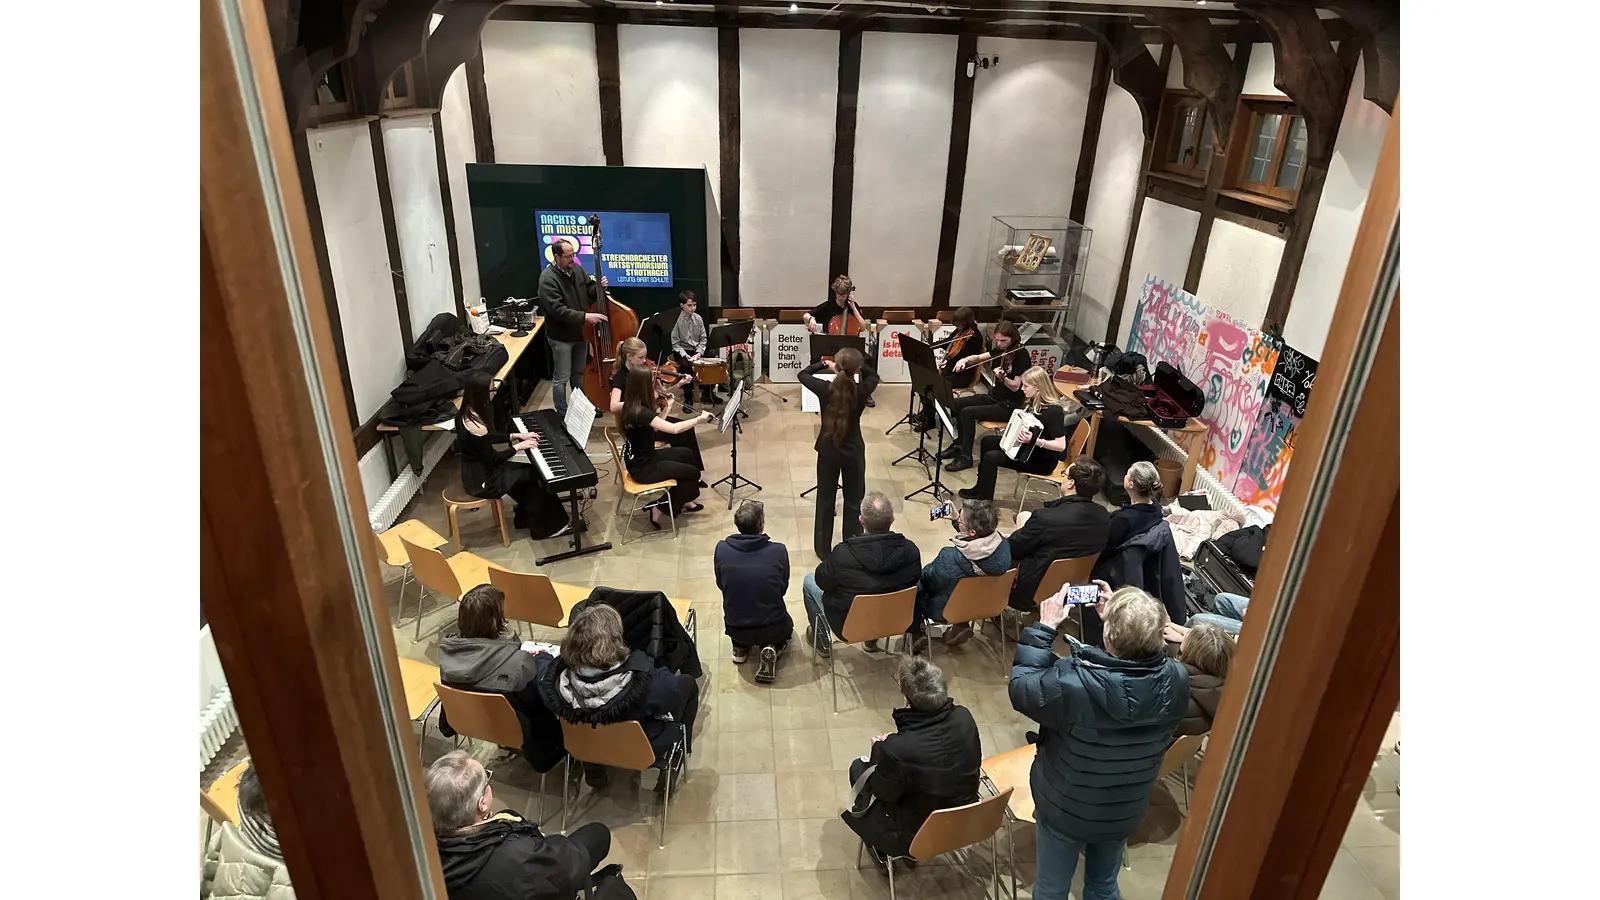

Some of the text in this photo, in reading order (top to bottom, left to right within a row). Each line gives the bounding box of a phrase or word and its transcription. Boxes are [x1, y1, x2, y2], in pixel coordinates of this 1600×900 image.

[540, 214, 576, 225] NACHTS
[541, 224, 554, 234] IM
[601, 253, 668, 263] STREICHORCHESTER
[608, 261, 669, 270] RATSGYMNASIUM
[625, 269, 669, 277] STADTHAGEN
[778, 334, 804, 343] Better
[890, 331, 911, 339] Gd
[778, 343, 799, 352] done
[882, 340, 891, 349] is
[777, 352, 796, 360] than
[777, 360, 802, 370] perfct
